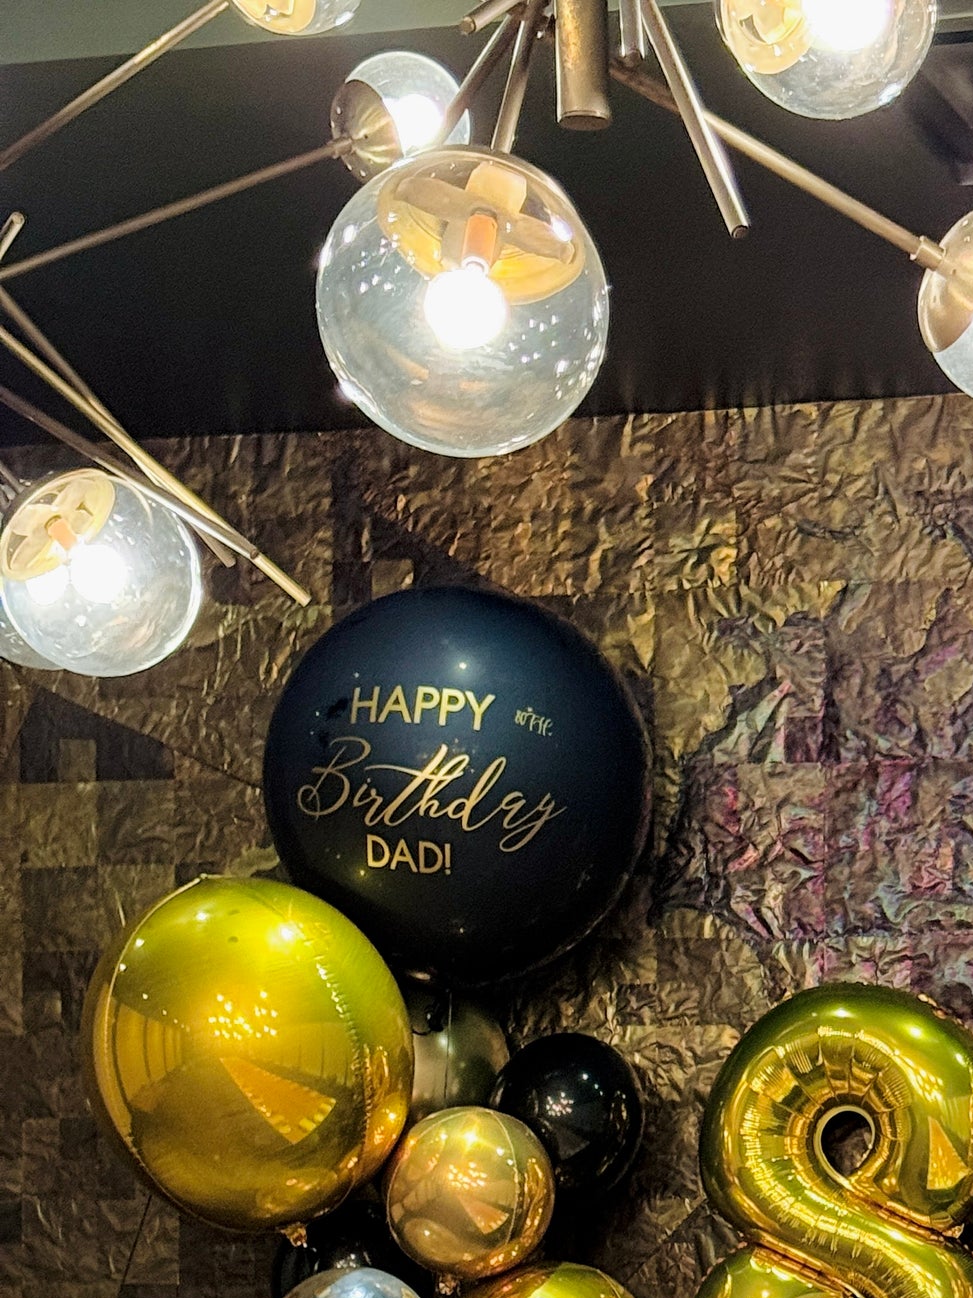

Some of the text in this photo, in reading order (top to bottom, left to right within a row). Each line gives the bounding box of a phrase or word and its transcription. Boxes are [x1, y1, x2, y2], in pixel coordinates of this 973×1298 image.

[350, 684, 496, 731] HAPPY
[297, 736, 568, 852] Birthday
[366, 834, 451, 875] DAD!
